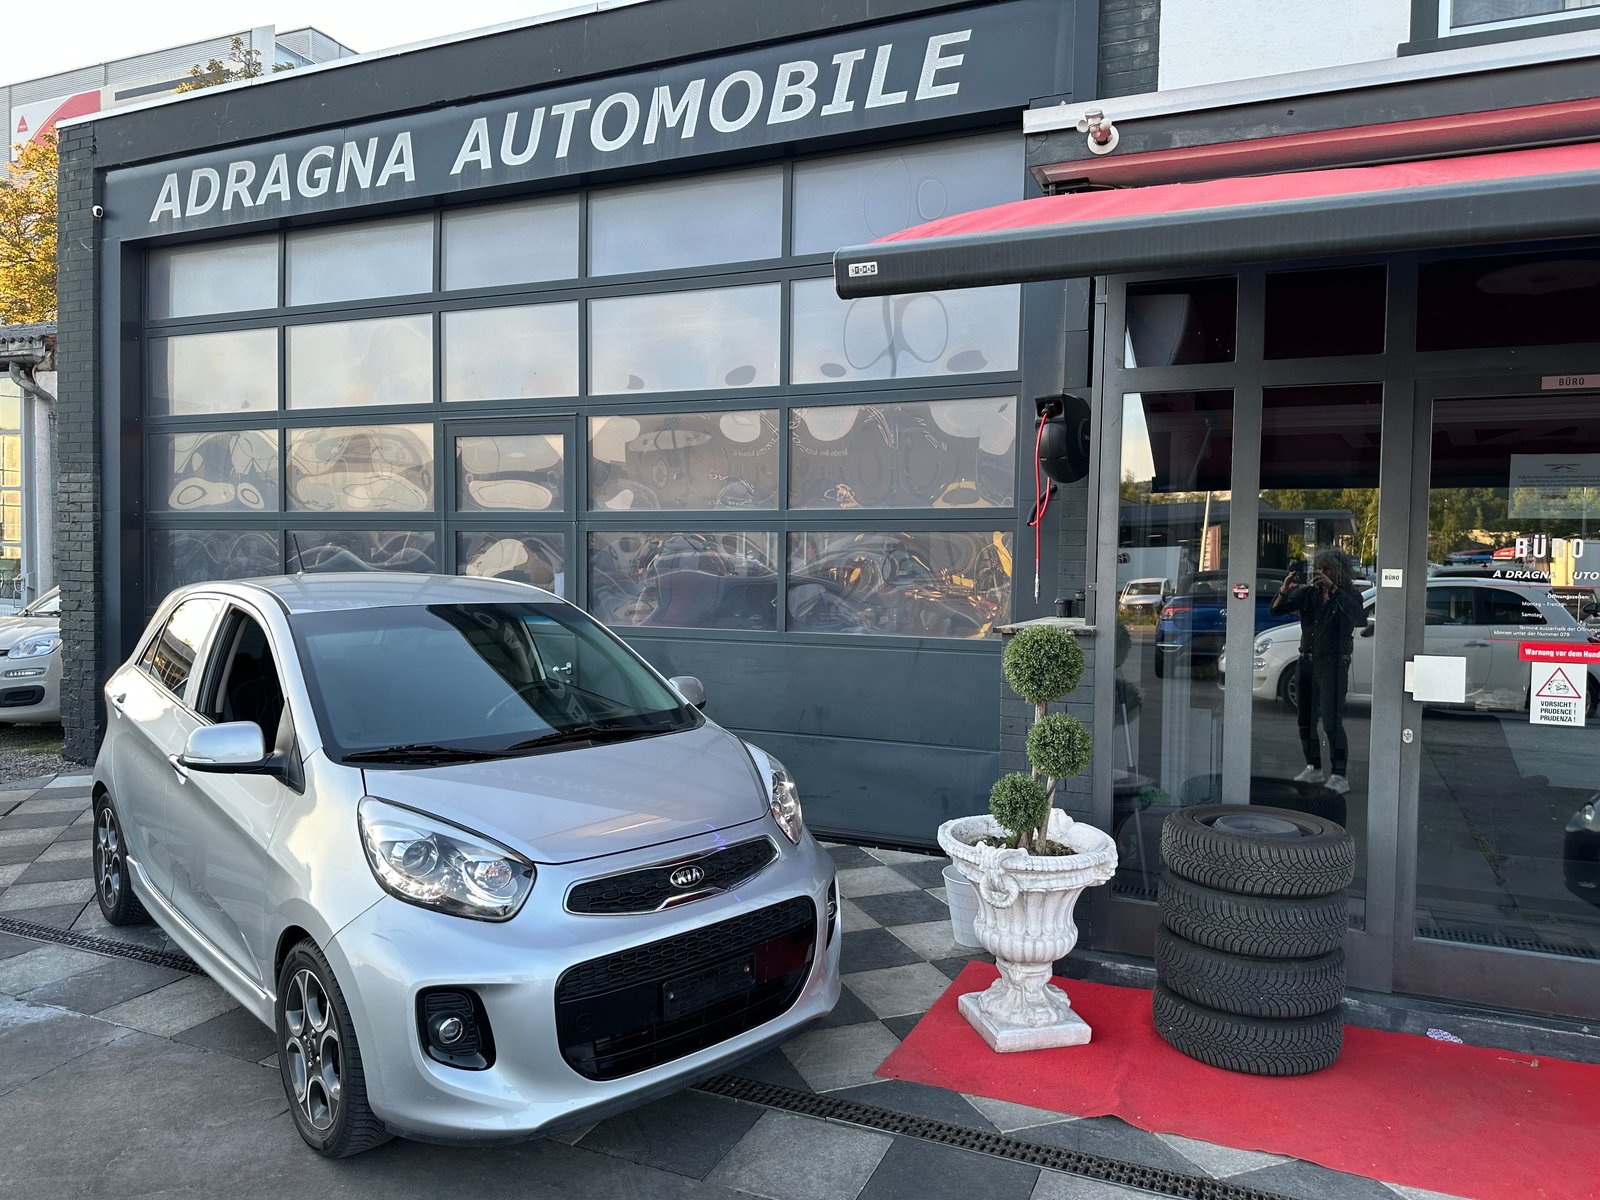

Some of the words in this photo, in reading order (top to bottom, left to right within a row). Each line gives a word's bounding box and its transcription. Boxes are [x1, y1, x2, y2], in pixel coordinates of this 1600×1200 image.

[149, 131, 416, 223] ADRAGNA
[449, 29, 972, 175] AUTOMOBILE
[1559, 376, 1584, 386] BÜRO
[1516, 534, 1584, 558] BÜRO
[1384, 573, 1400, 581] BÜRO
[1524, 648, 1554, 657] Warnung
[1568, 649, 1582, 657] dem
[1583, 650, 1600, 658] Hund
[675, 868, 701, 884] KIA
